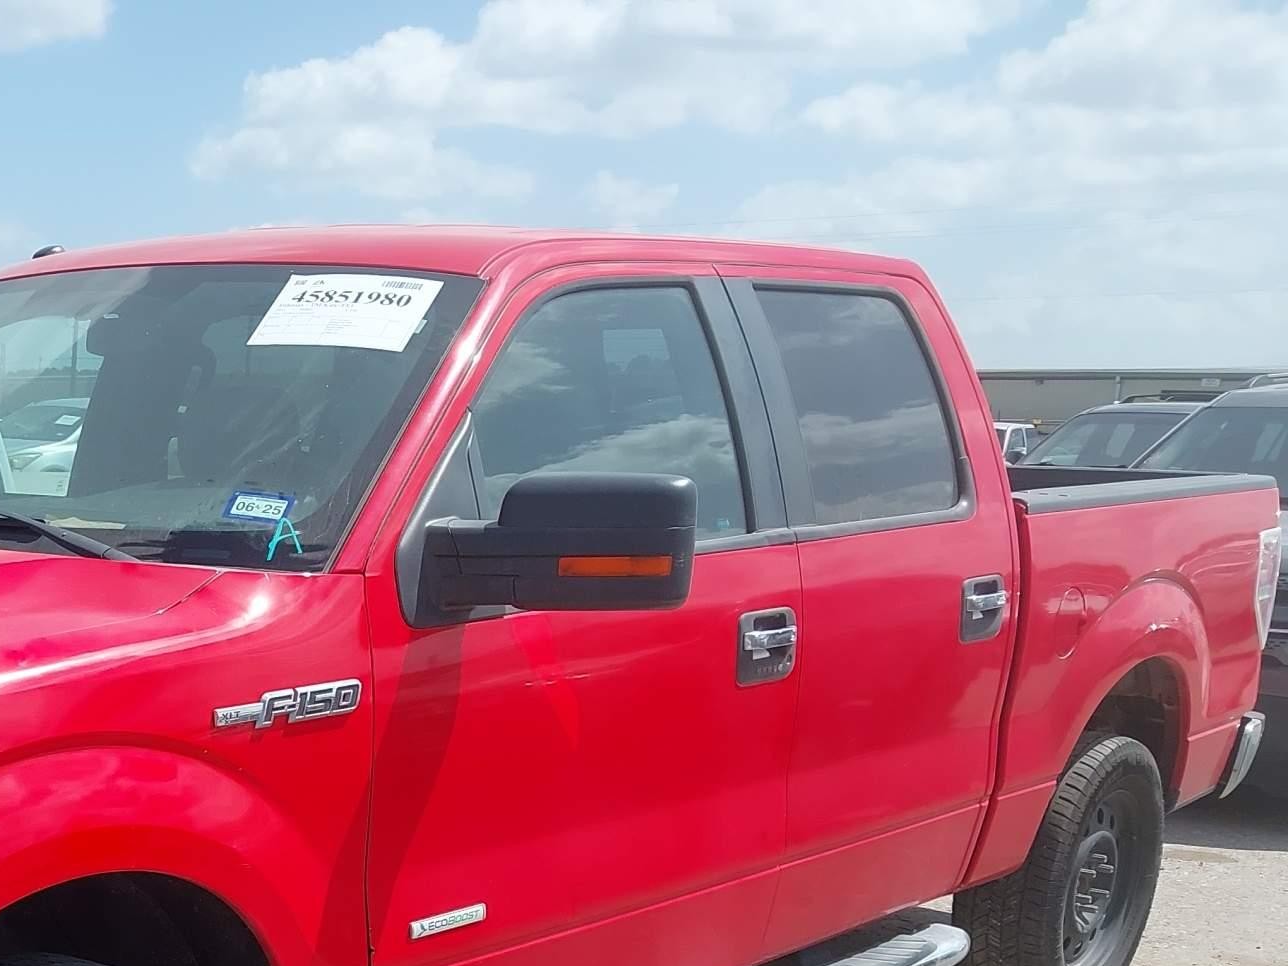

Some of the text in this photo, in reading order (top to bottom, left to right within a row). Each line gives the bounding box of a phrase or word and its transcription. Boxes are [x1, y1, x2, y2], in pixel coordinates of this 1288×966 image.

[291, 289, 412, 308] 45851980
[220, 678, 363, 729] XLT F-150
[427, 909, 481, 932] ECOBOOST
